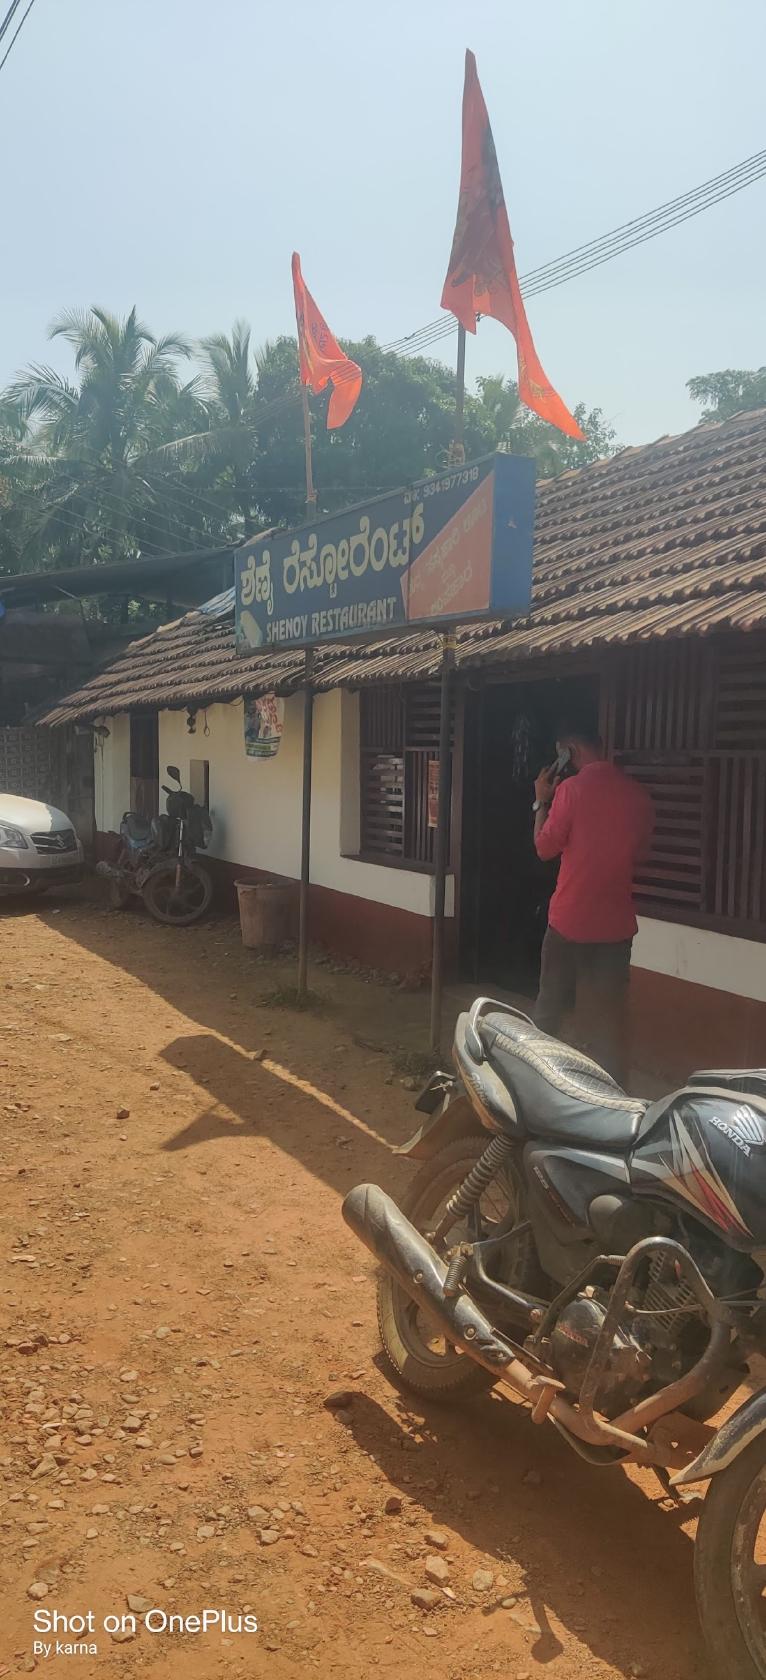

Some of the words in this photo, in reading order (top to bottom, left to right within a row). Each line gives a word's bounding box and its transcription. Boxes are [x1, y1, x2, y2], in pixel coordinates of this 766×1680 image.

[266, 615, 309, 643] SHENOY
[311, 596, 397, 636] RESTAURANT
[708, 1115, 751, 1158] HONDA
